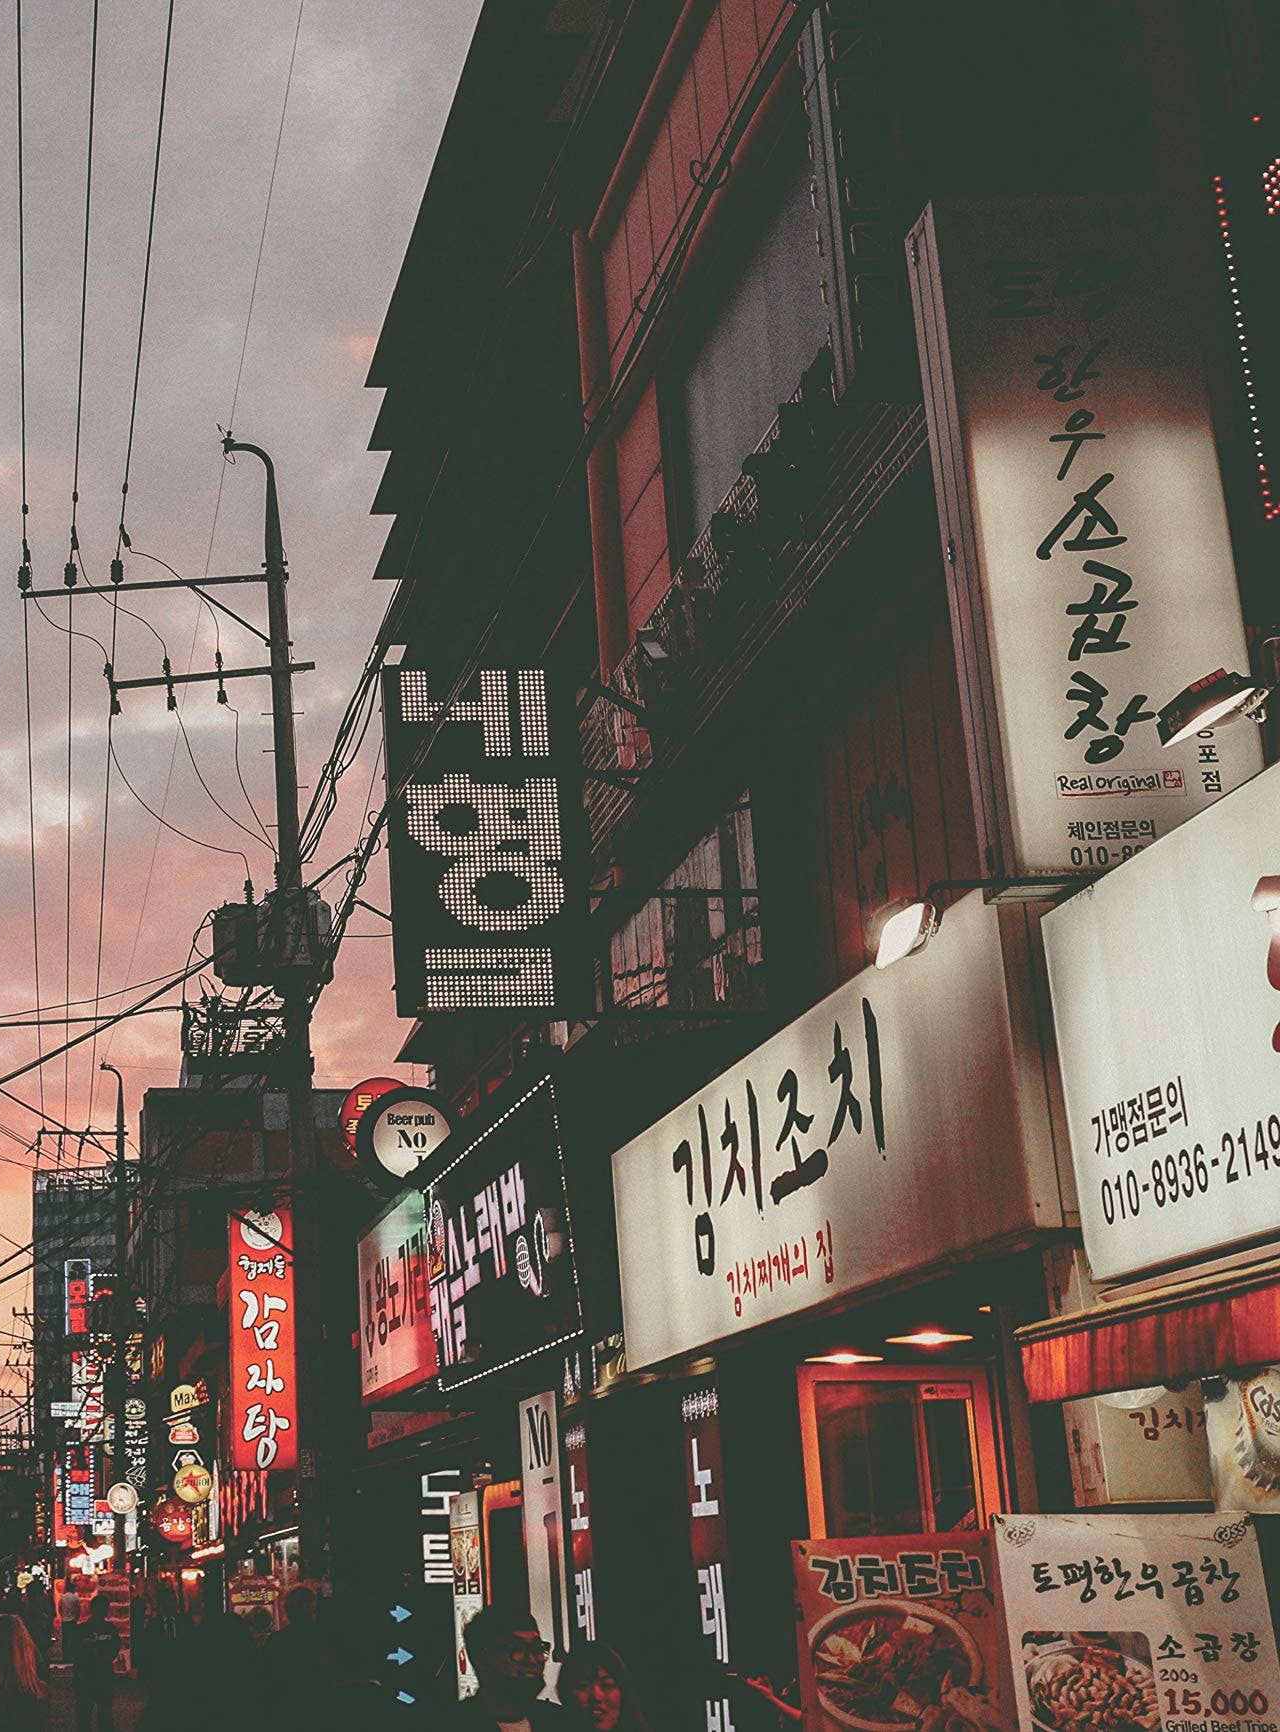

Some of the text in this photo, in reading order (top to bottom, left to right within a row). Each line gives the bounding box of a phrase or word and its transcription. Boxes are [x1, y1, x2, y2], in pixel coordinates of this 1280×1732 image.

[1057, 772, 1161, 794] Real Original
[1067, 819, 1157, 842] 체인점문의
[386, 1112, 436, 1129] Beer pub
[1091, 1075, 1190, 1158] 가맹점문의
[673, 997, 886, 1277] 김치조치
[237, 1253, 287, 1281] 형제들
[725, 1219, 835, 1318] 김치찌개의 집
[241, 1290, 290, 1470] 감자탕
[173, 1393, 196, 1407] Max
[1214, 1521, 1247, 1544] Cass
[1158, 1667, 1199, 1684] 200g
[1163, 1688, 1269, 1718] 15,000
[1165, 1719, 1278, 1732] Grilled Beef Tripe
